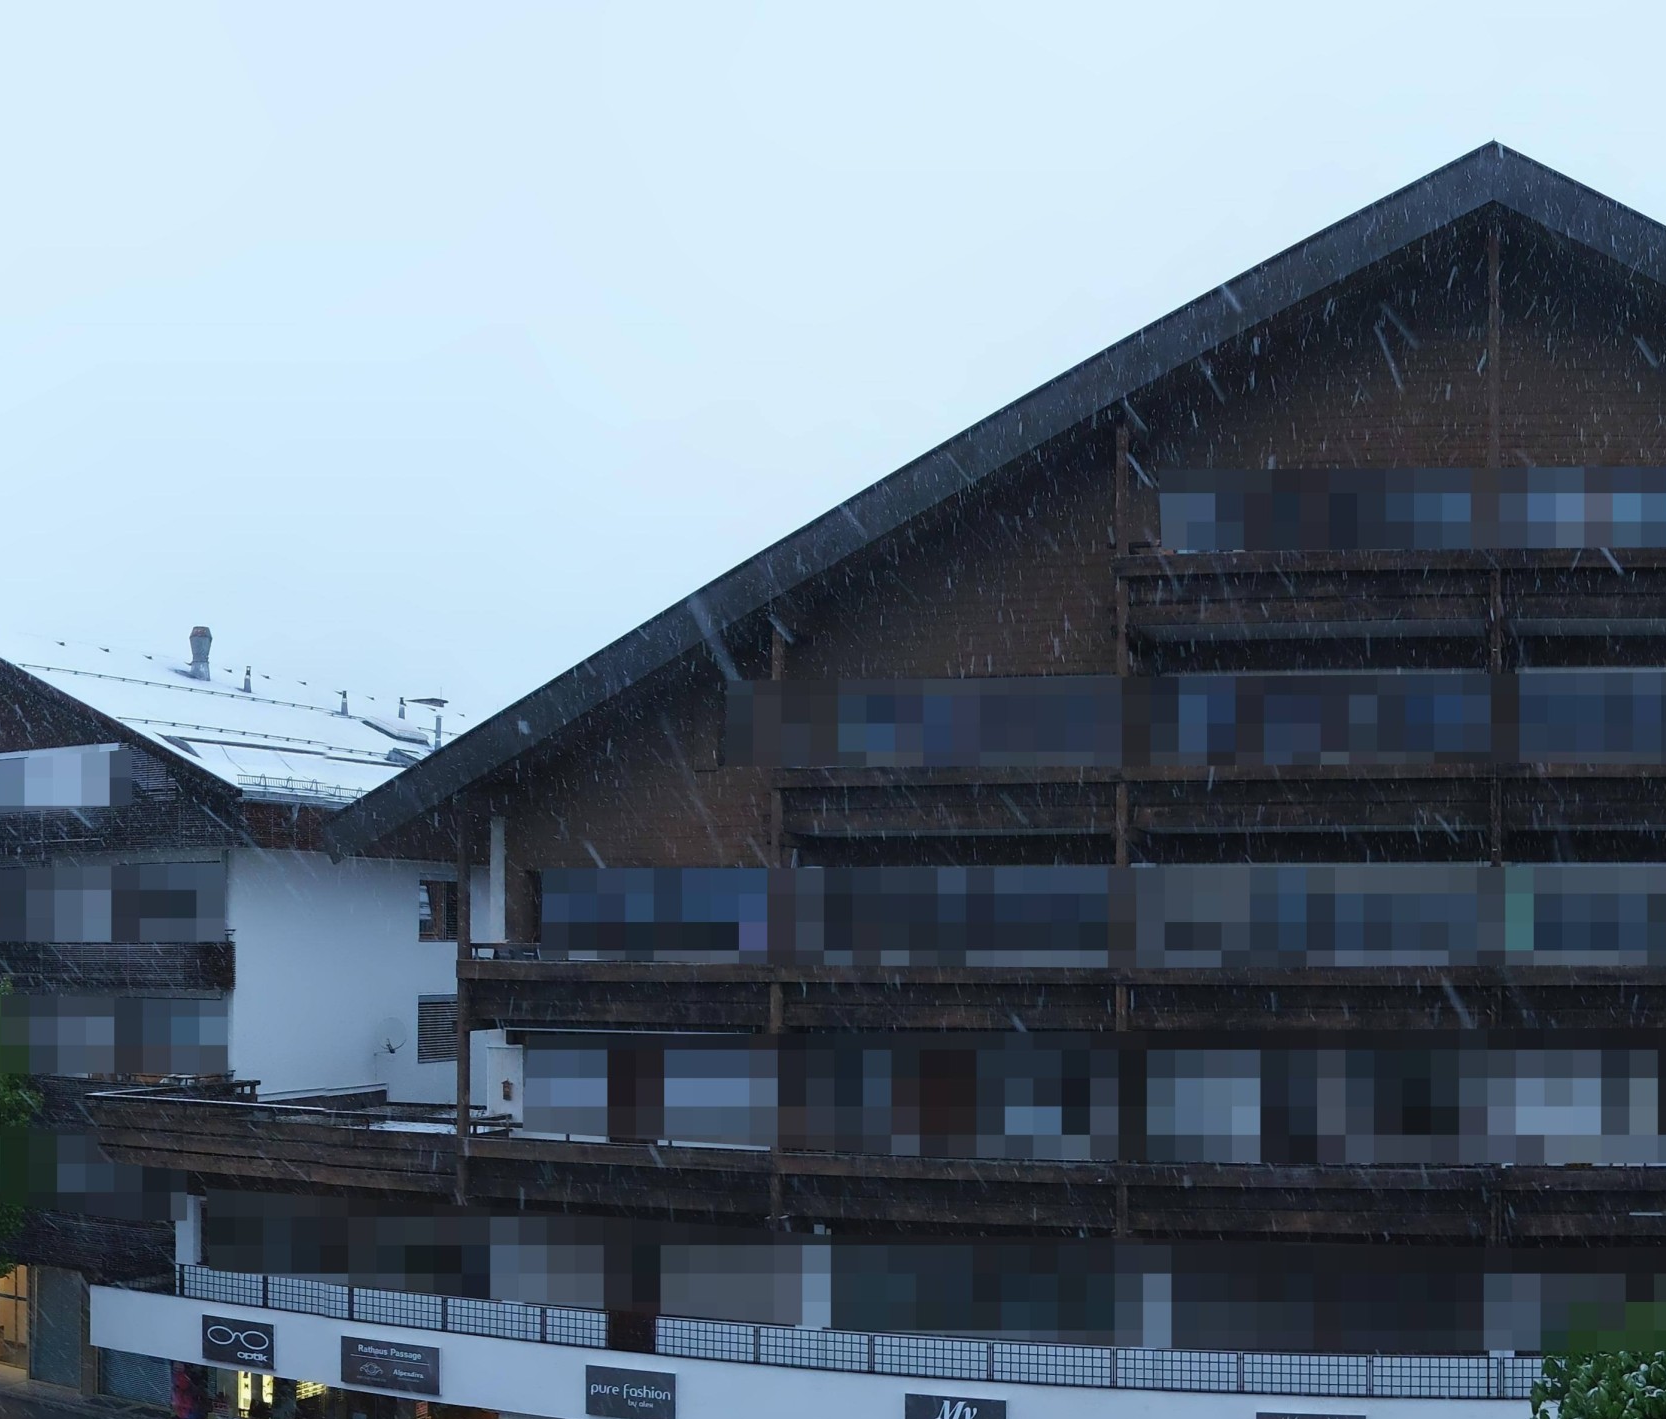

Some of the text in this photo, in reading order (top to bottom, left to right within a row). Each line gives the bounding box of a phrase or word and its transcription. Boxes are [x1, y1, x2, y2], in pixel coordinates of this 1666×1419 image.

[237, 1351, 268, 1363] optik
[358, 1344, 422, 1361] Rathaus Passage
[590, 1383, 671, 1401] pure fashion
[627, 1399, 638, 1408] by
